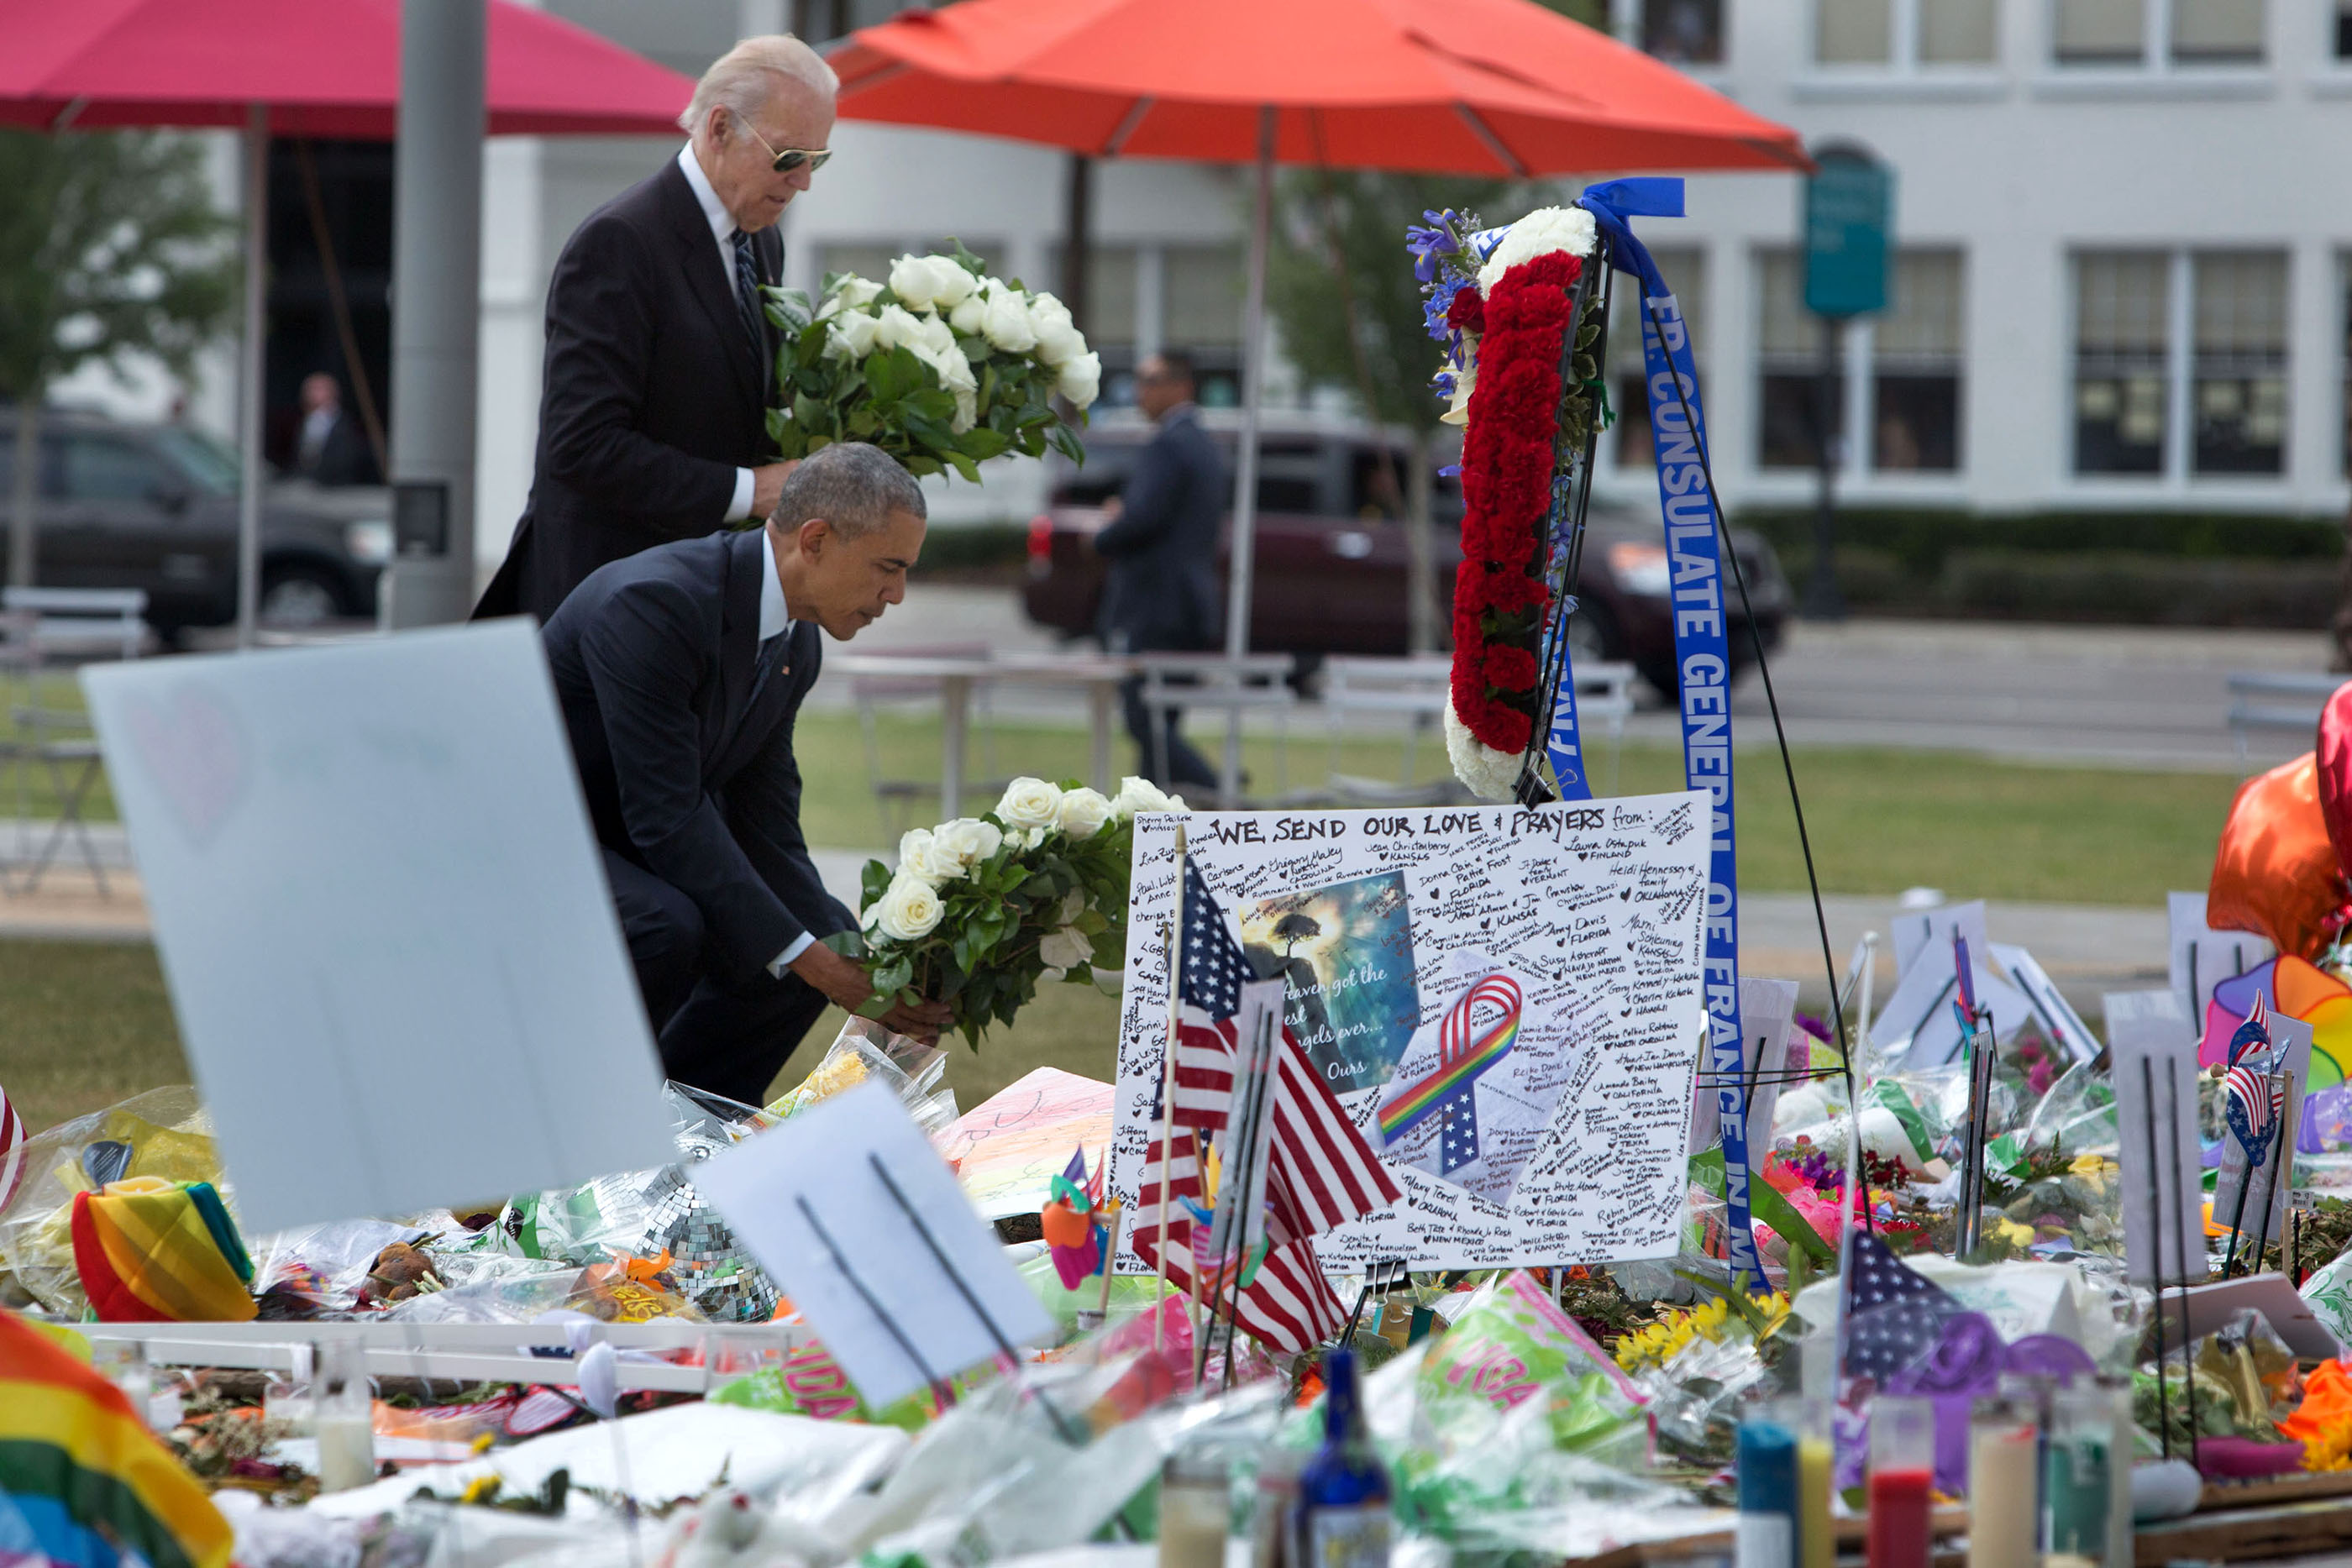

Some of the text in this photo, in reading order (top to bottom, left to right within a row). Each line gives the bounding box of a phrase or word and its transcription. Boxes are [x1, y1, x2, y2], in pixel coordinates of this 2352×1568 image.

[1651, 371, 1721, 637] CONSULATE
[1704, 957, 1745, 1142] FRANCE
[1725, 1162, 1748, 1208] IN
[1210, 818, 1266, 845] WE
[1273, 818, 1346, 842] SEND
[1364, 817, 1415, 838] OUR
[1424, 811, 1483, 836] LOVE
[1494, 812, 1503, 831] &
[1510, 808, 1605, 843] PRAYERS
[1613, 805, 1653, 829] from:
[1366, 842, 1389, 853] Jean
[1590, 849, 1632, 861] FINLAND
[1139, 851, 1161, 867] Lisa
[1390, 852, 1431, 862] KANSAS
[1487, 853, 1512, 870] Frost
[1530, 868, 1569, 884] VERMONT
[1609, 861, 1639, 877] Heidi
[1420, 871, 1450, 887] Donna
[1451, 878, 1492, 901] FLORIDA
[1497, 907, 1539, 928] KANSAS
[1462, 928, 1497, 941] Murray
[1545, 914, 1607, 939] Amy Davis
[1446, 937, 1493, 950] CALIFORNIA
[1571, 926, 1611, 946] FLORIDA
[1564, 955, 1622, 975] NAVAJO NATION
[1332, 968, 1359, 997] got
[1360, 962, 1388, 983] the
[1576, 971, 1597, 983] NEW
[1614, 1039, 1637, 1050] NORTH
[1328, 1062, 1368, 1080] Ours
[1634, 1062, 1653, 1073] NEW
[1613, 1087, 1664, 1099] CALIFORNIA
[1431, 1235, 1485, 1245] NEW MEXICO
